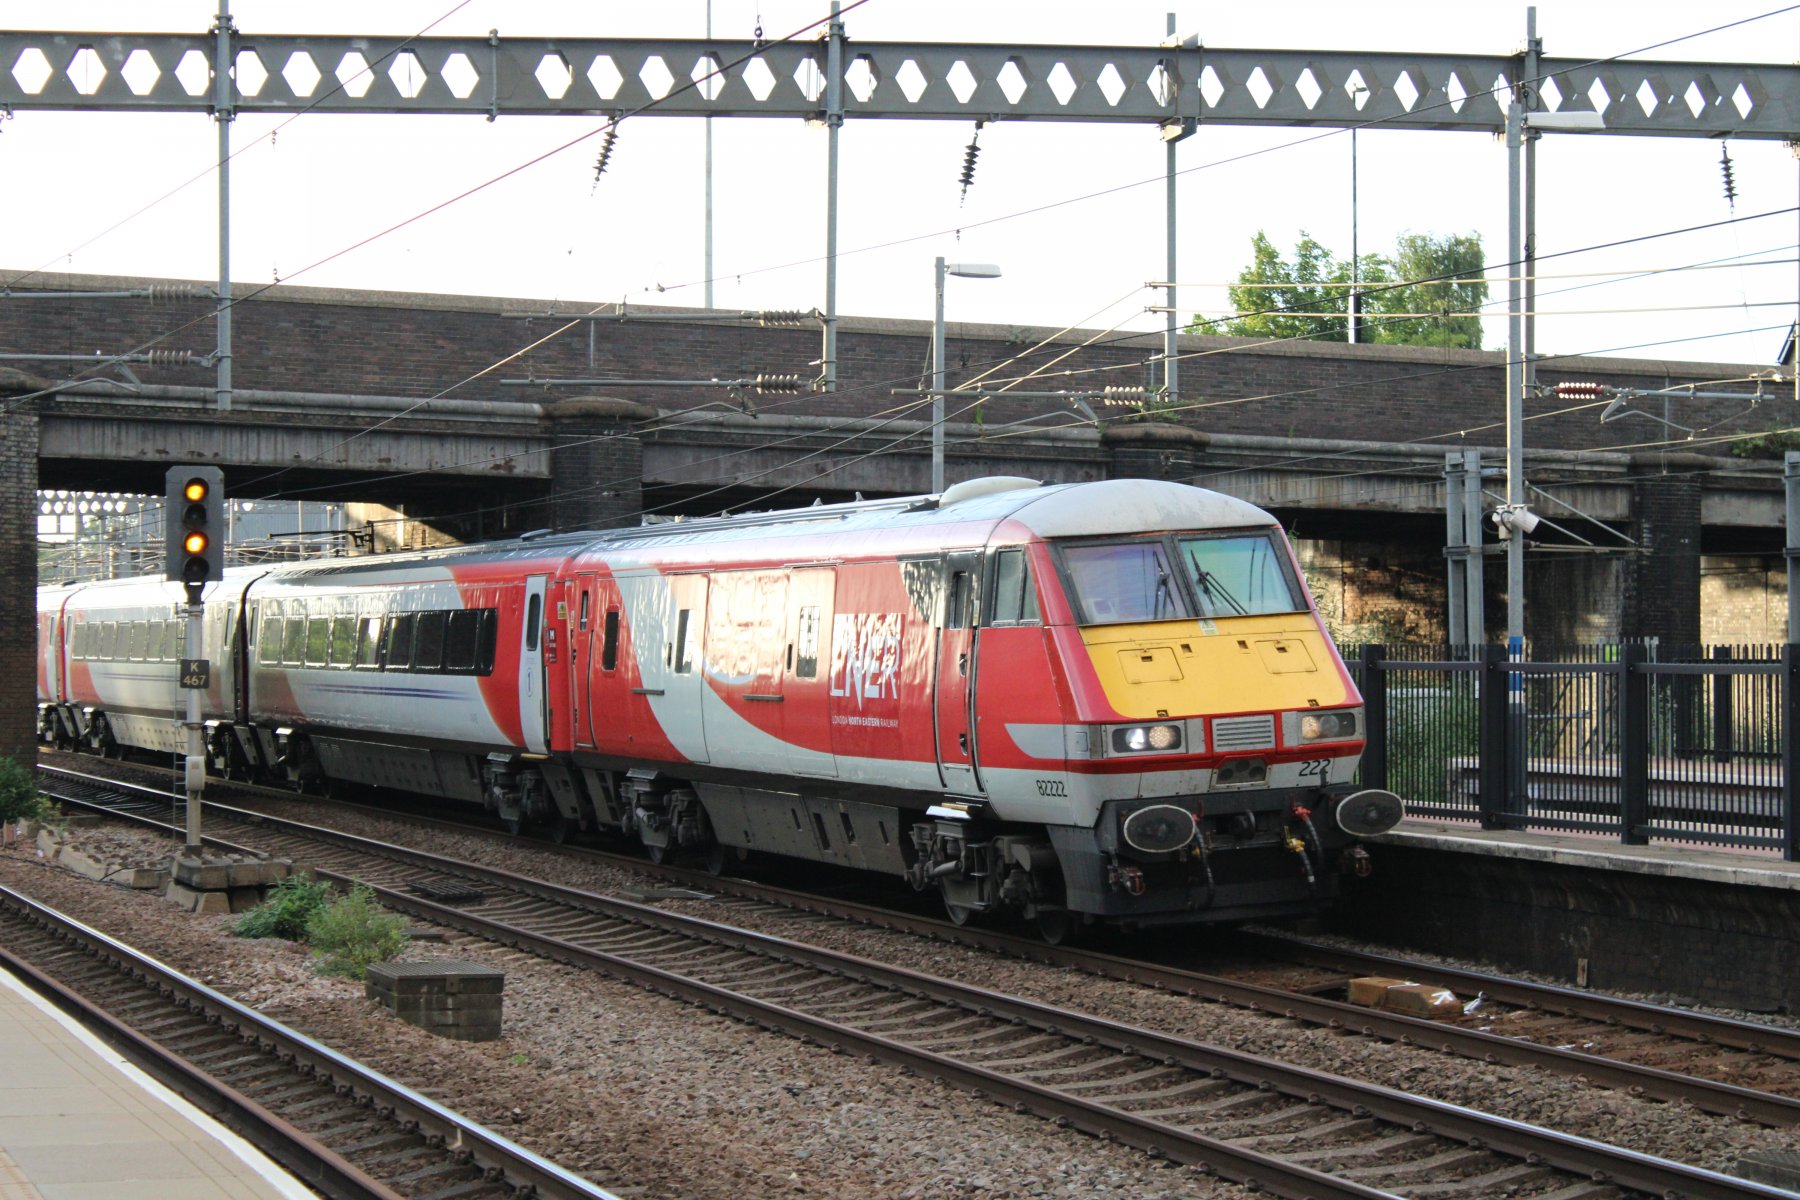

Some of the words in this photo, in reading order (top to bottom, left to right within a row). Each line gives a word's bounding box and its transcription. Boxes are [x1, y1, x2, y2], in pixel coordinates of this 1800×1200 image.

[190, 662, 199, 673] K
[830, 636, 900, 712] LNER
[183, 675, 206, 686] 467
[831, 715, 848, 725] LONDON
[848, 716, 862, 726] NORTH
[862, 717, 880, 727] EASTERN
[1298, 758, 1331, 777] 222
[1036, 780, 1068, 798] 82222
